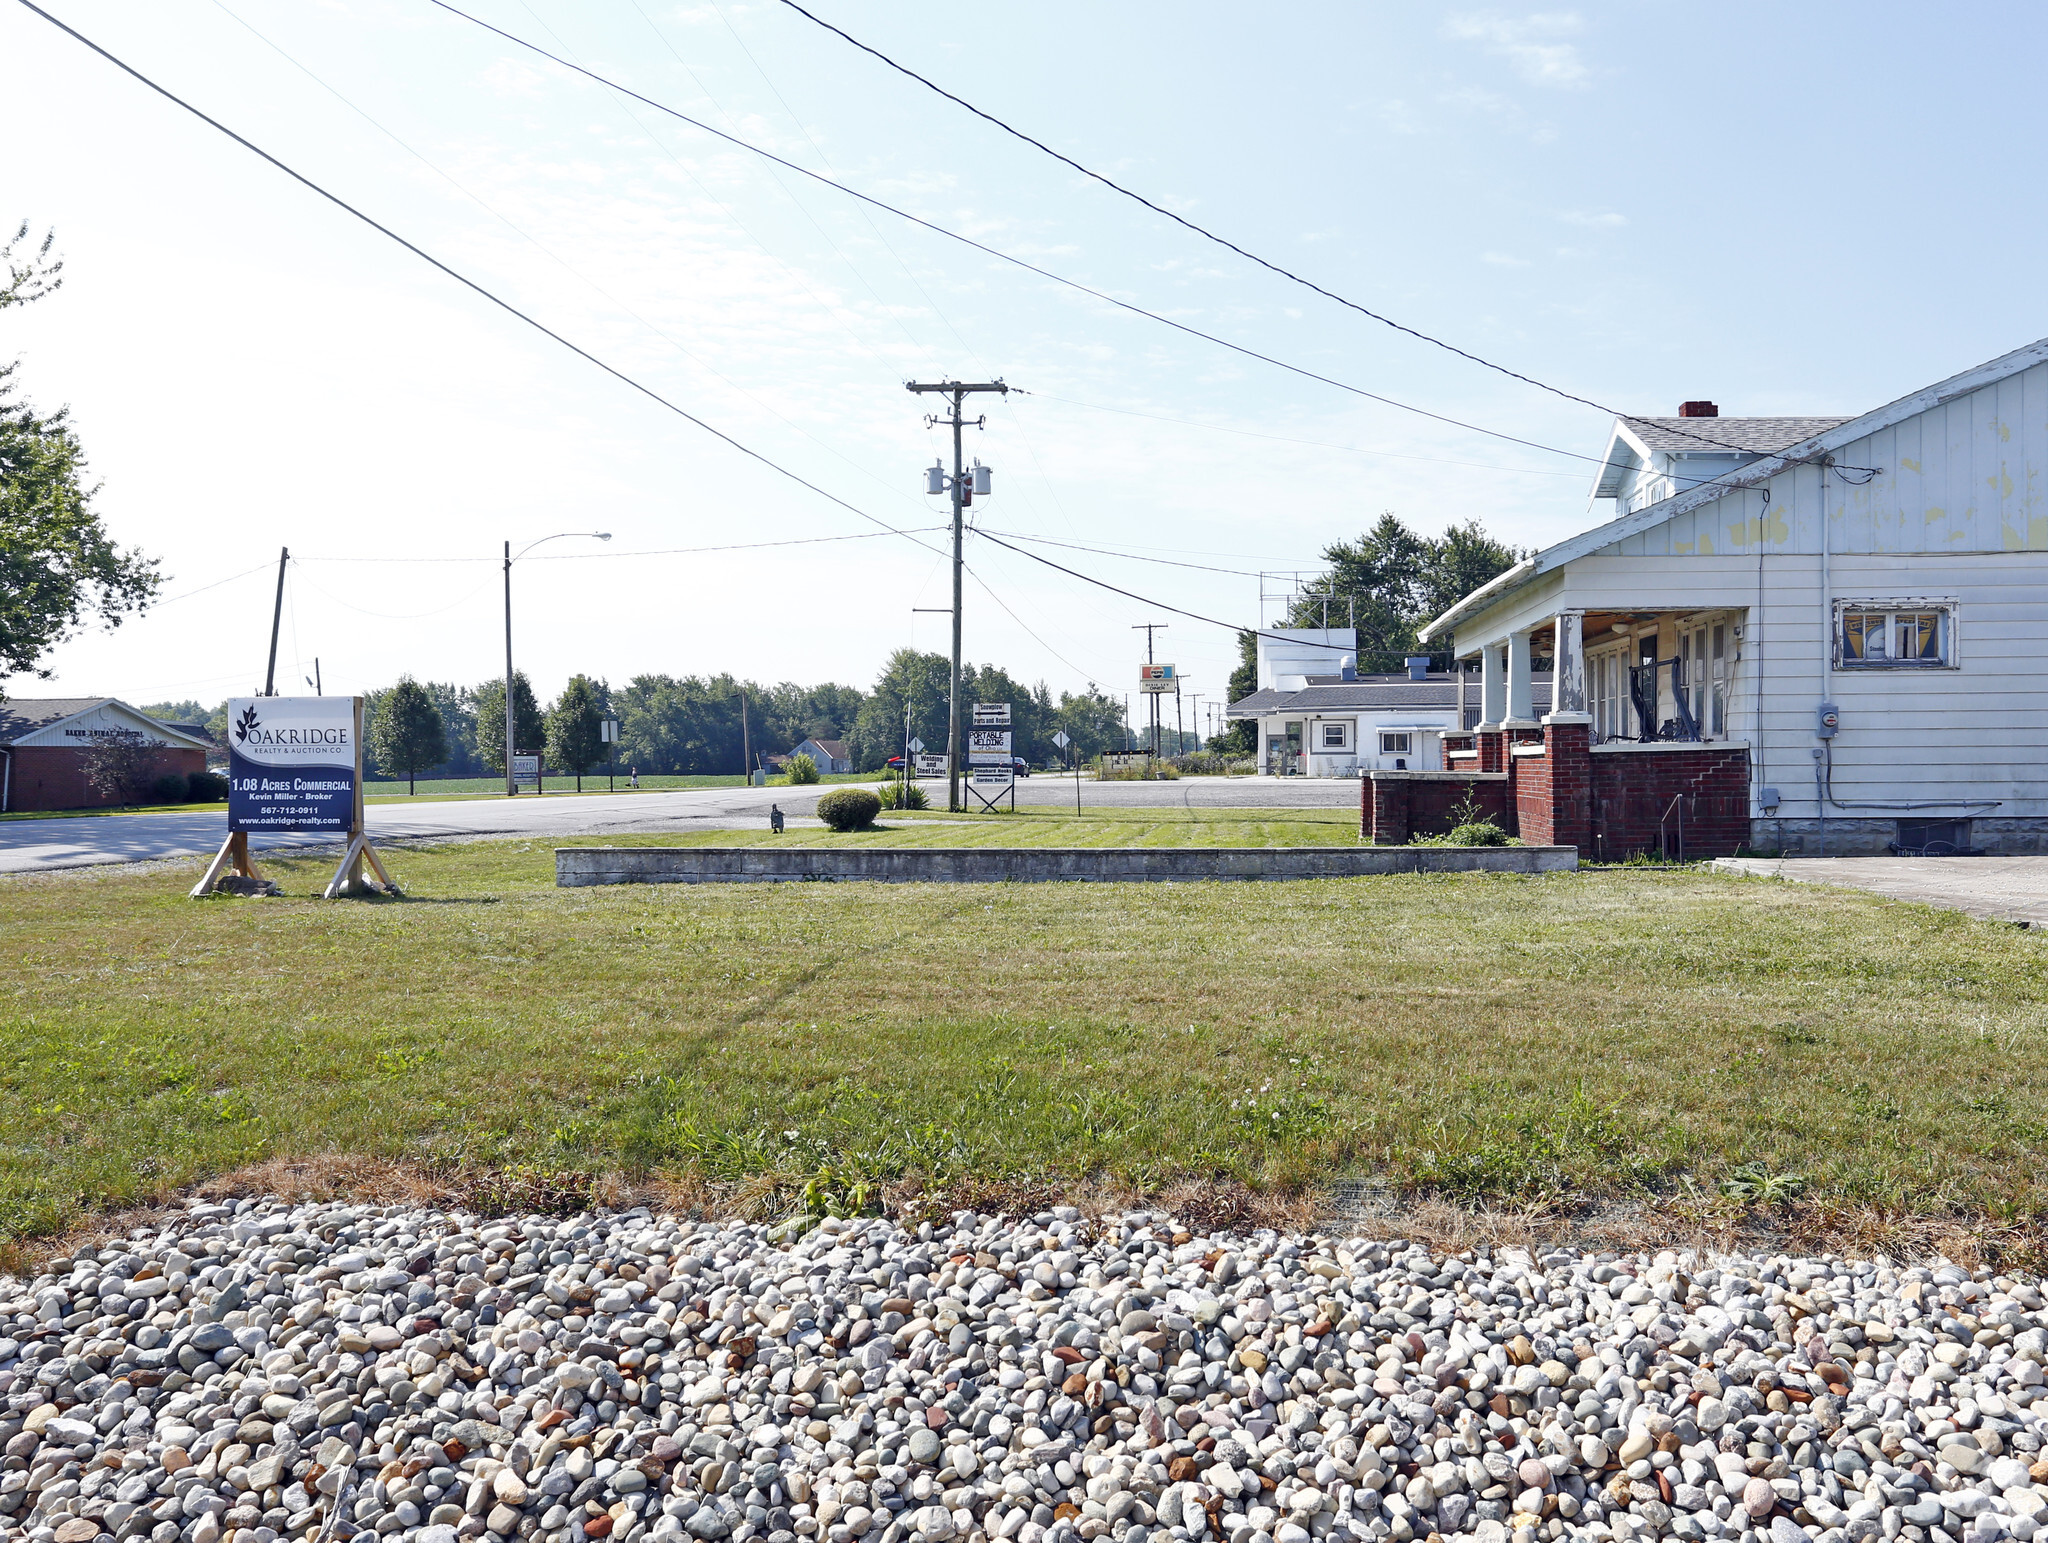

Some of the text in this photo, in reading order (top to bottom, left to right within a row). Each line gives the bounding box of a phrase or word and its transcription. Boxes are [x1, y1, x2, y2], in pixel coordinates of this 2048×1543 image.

[248, 729, 348, 744] OAKRIDGE
[970, 731, 1004, 739] PORTABLE
[232, 779, 257, 791] 1.08
[239, 816, 340, 825] www.oakridge-realty.com
